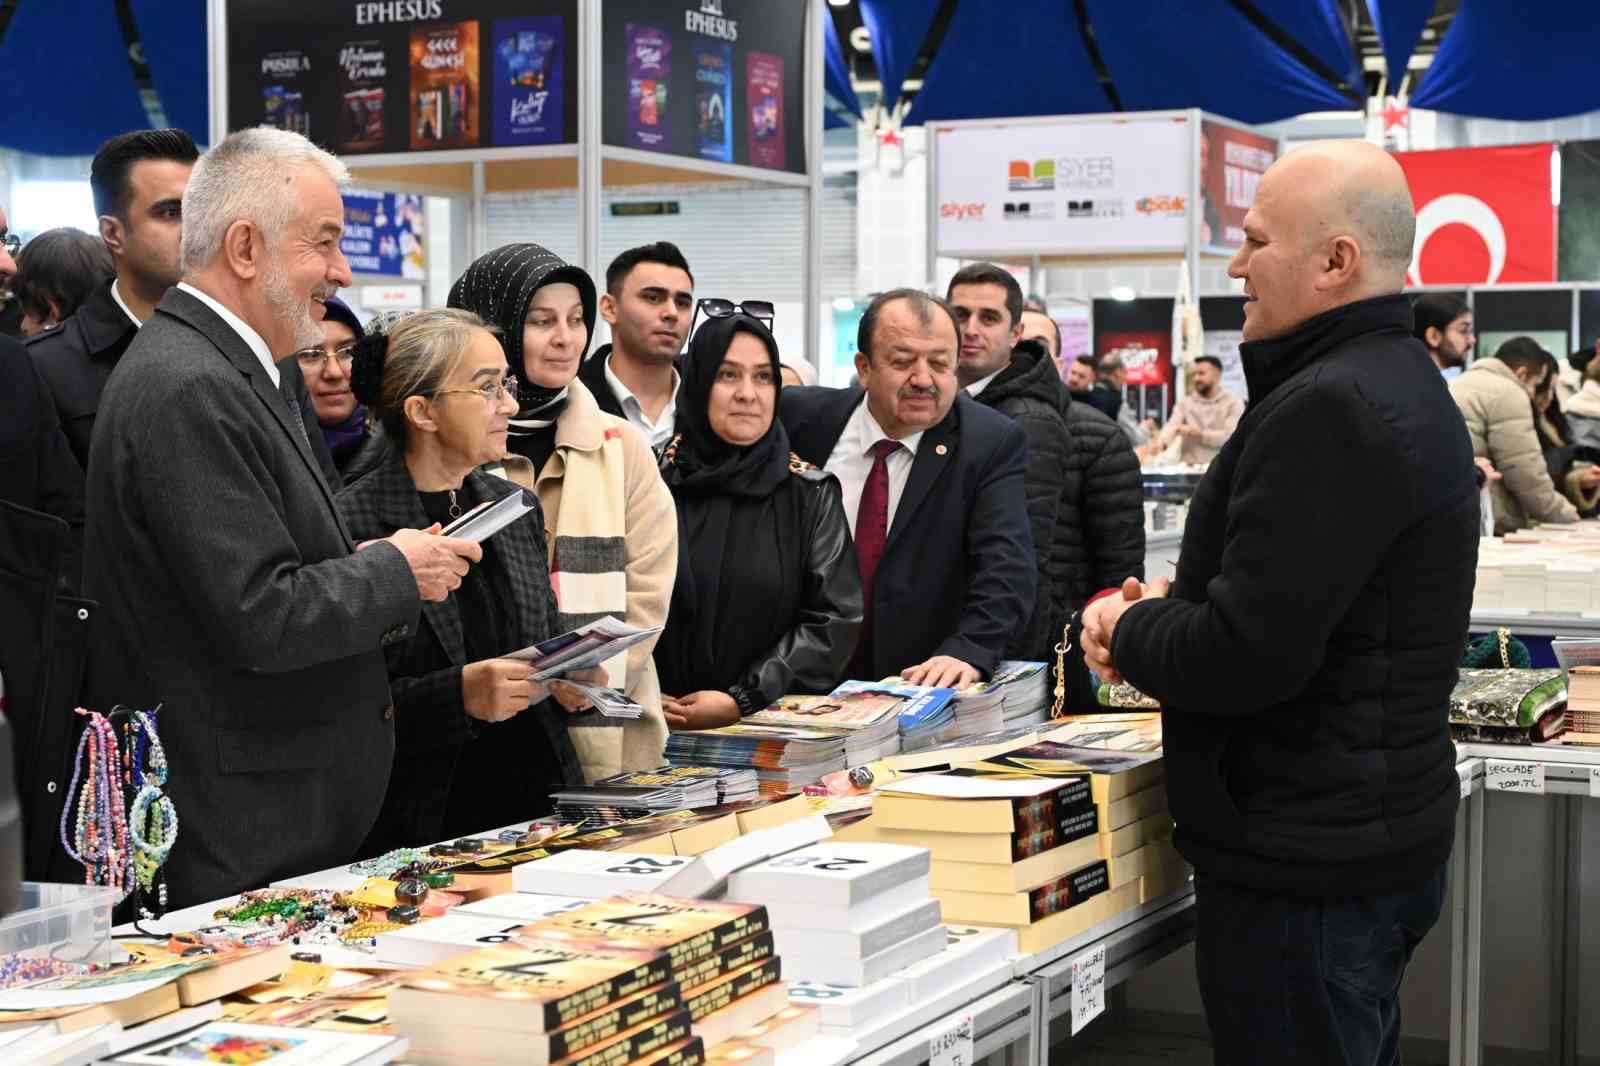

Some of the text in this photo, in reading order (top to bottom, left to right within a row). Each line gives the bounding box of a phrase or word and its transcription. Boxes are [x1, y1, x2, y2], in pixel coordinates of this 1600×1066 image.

[355, 0, 442, 25] EPHESUS
[685, 10, 738, 41] EPHESUS
[1488, 764, 1537, 776] SECCADE
